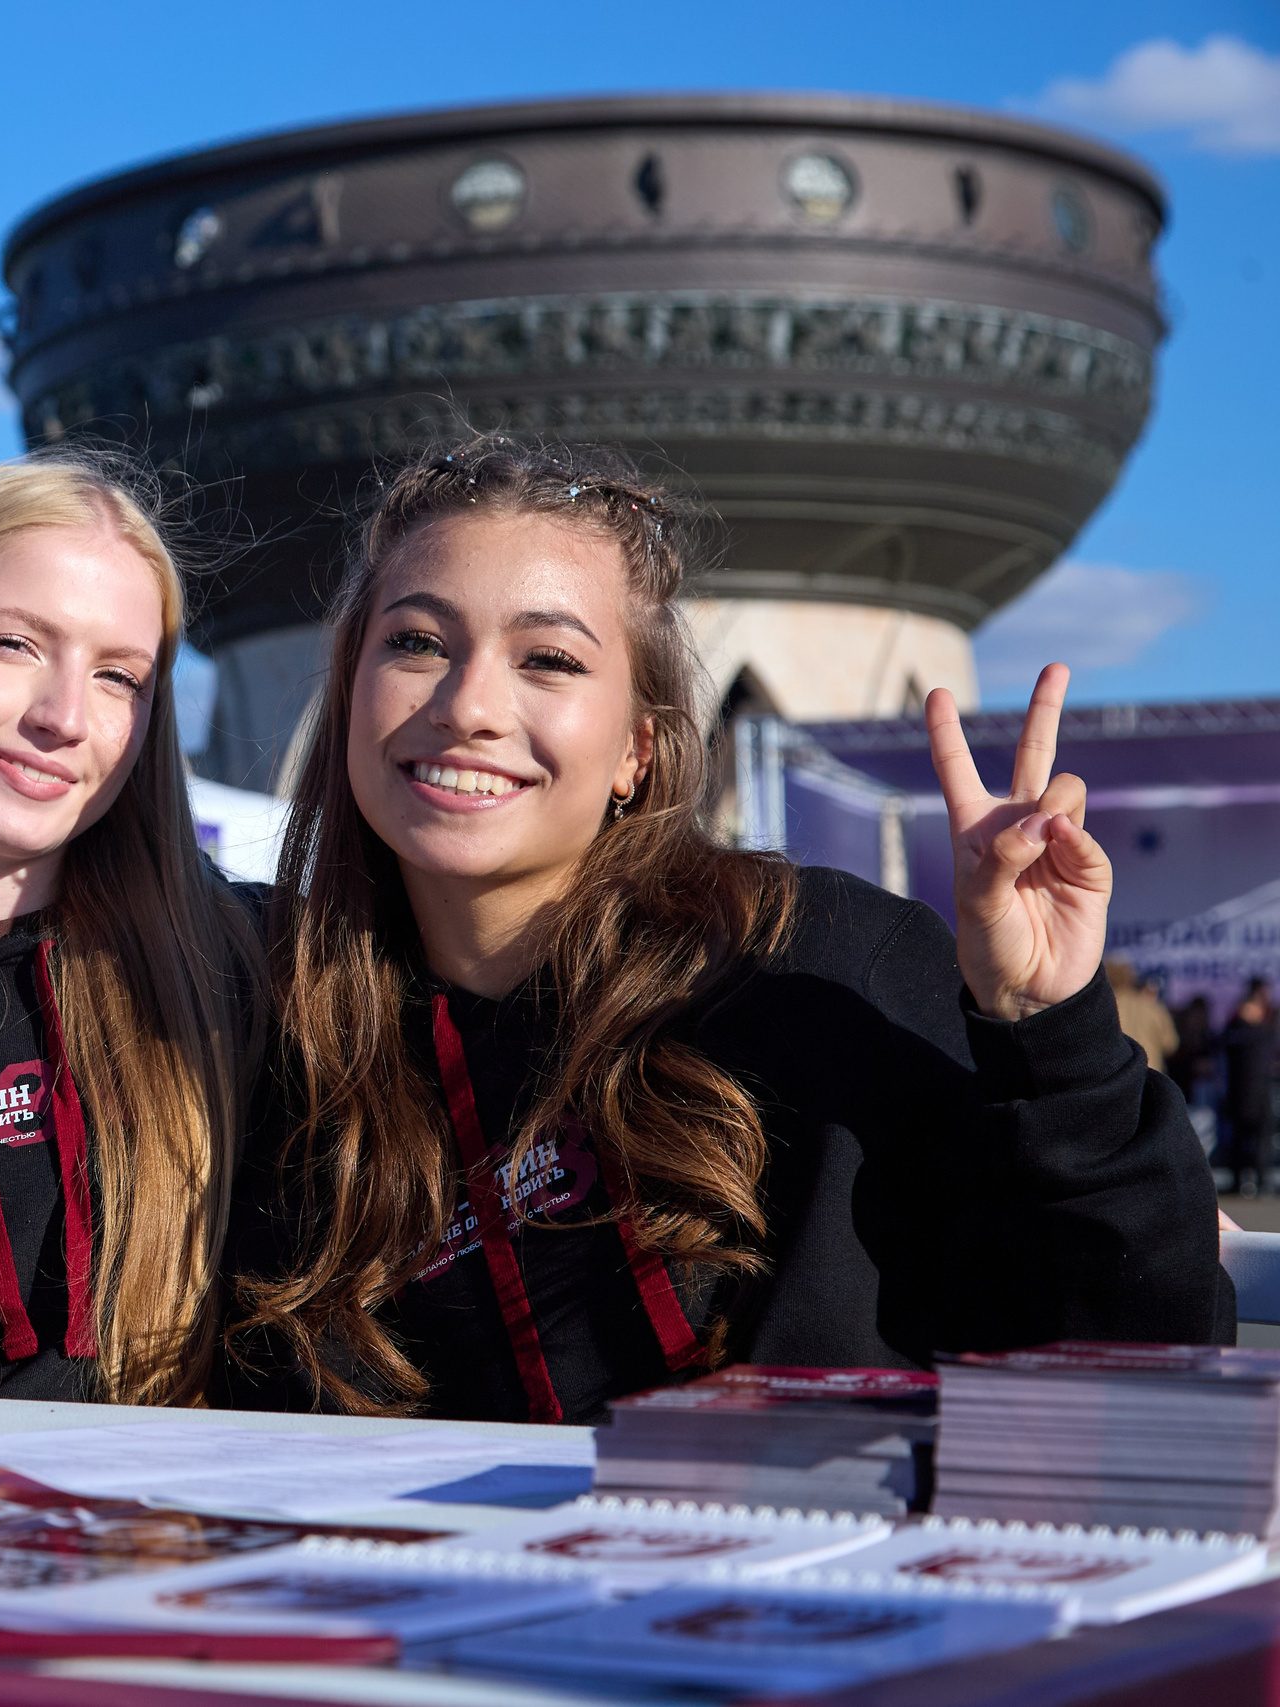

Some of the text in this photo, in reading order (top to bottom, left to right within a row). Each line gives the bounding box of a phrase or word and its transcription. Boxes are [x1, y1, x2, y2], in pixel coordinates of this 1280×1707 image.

[448, 1253, 456, 1261] С
[526, 1211, 534, 1219] С
[534, 1192, 571, 1213] ЧЕСТЬЮ
